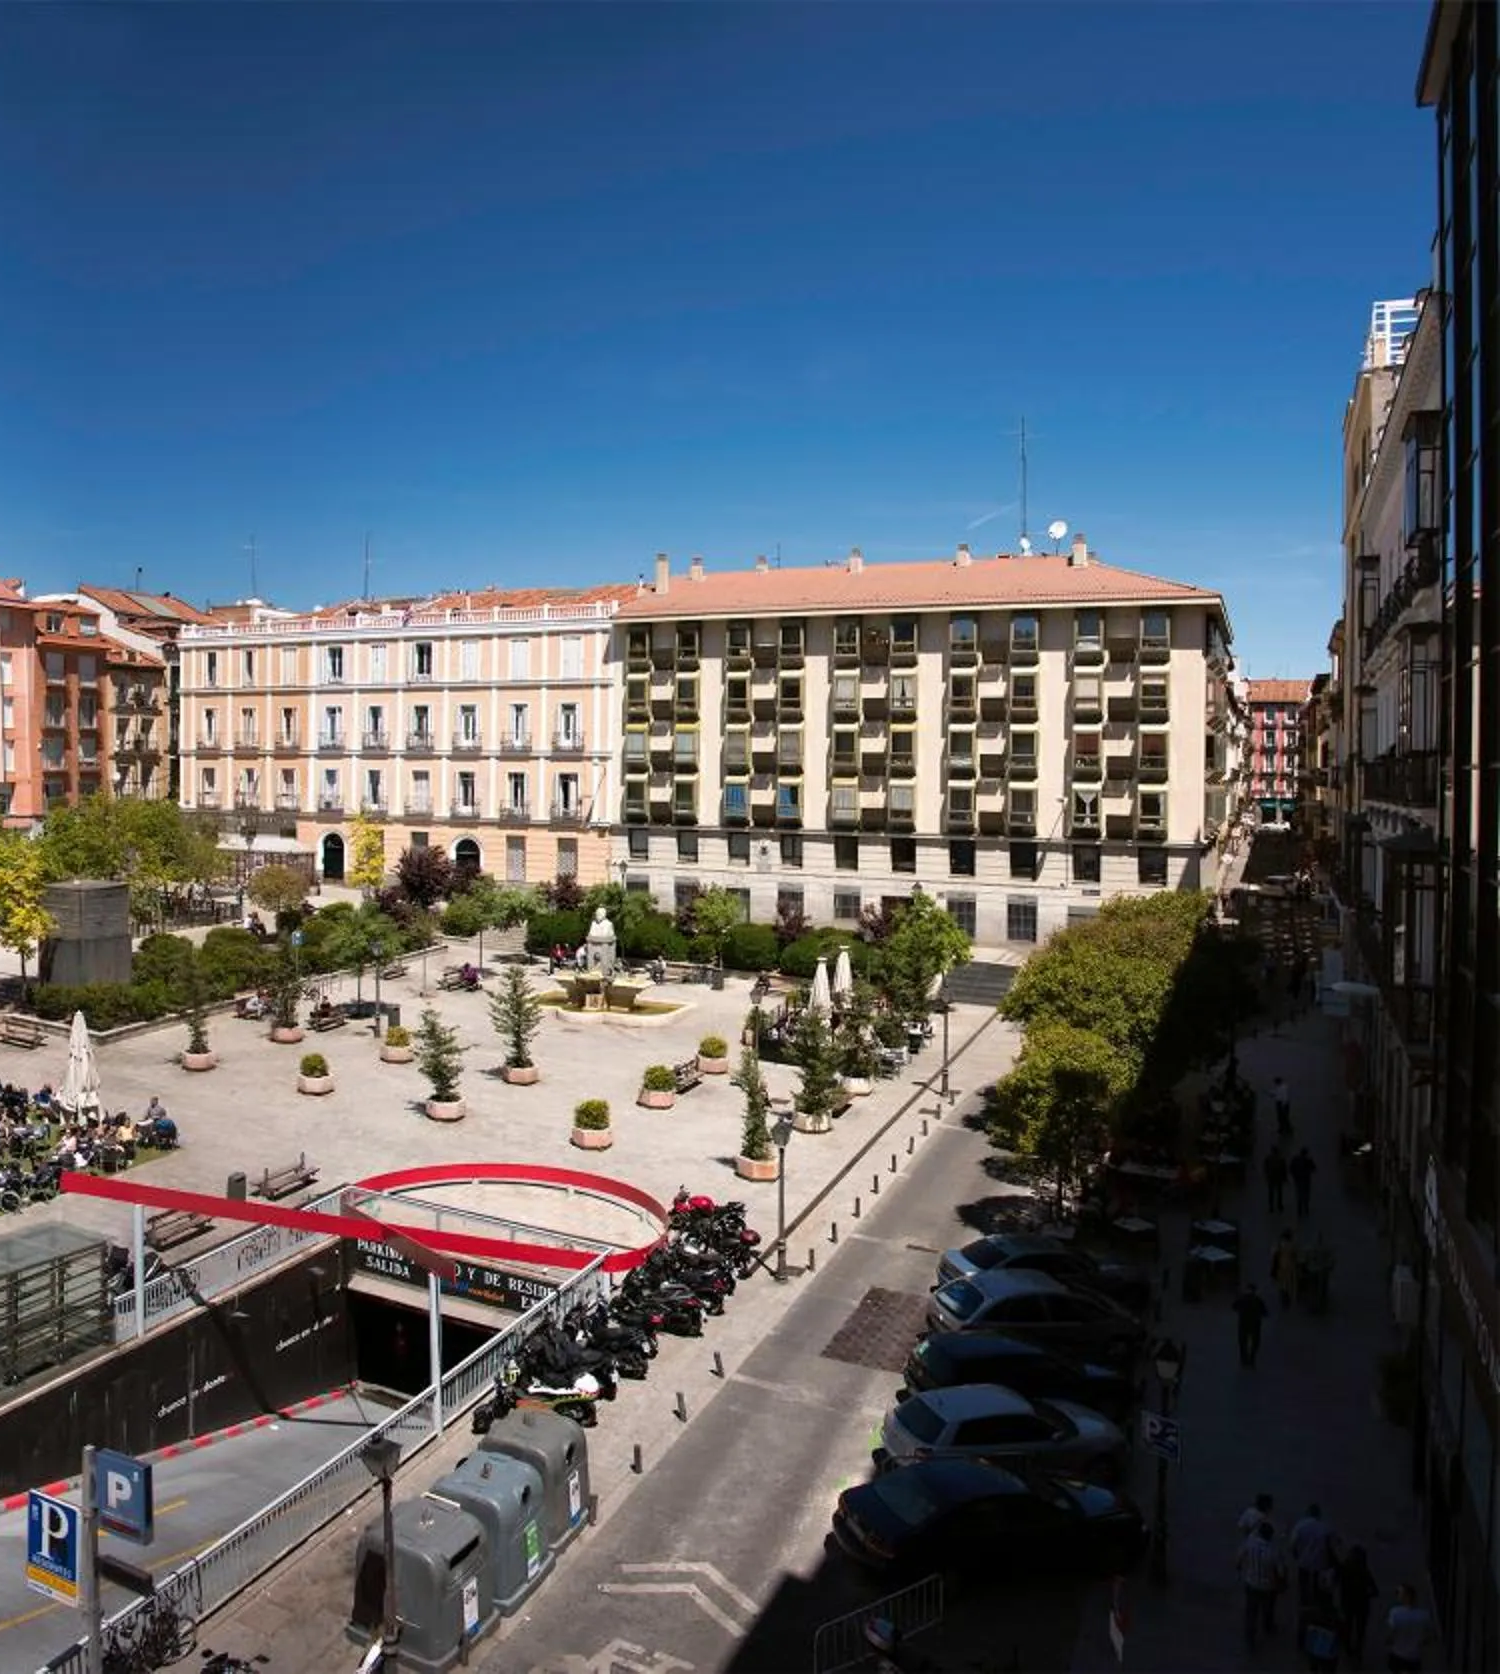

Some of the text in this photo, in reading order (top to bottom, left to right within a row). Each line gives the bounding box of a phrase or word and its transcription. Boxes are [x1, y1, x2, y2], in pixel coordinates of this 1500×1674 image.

[365, 1255, 411, 1279] SALIDA
[483, 1272, 501, 1287] DE
[508, 1277, 558, 1298] RESIDE
[107, 1471, 133, 1508] P
[36, 1498, 70, 1561] P
